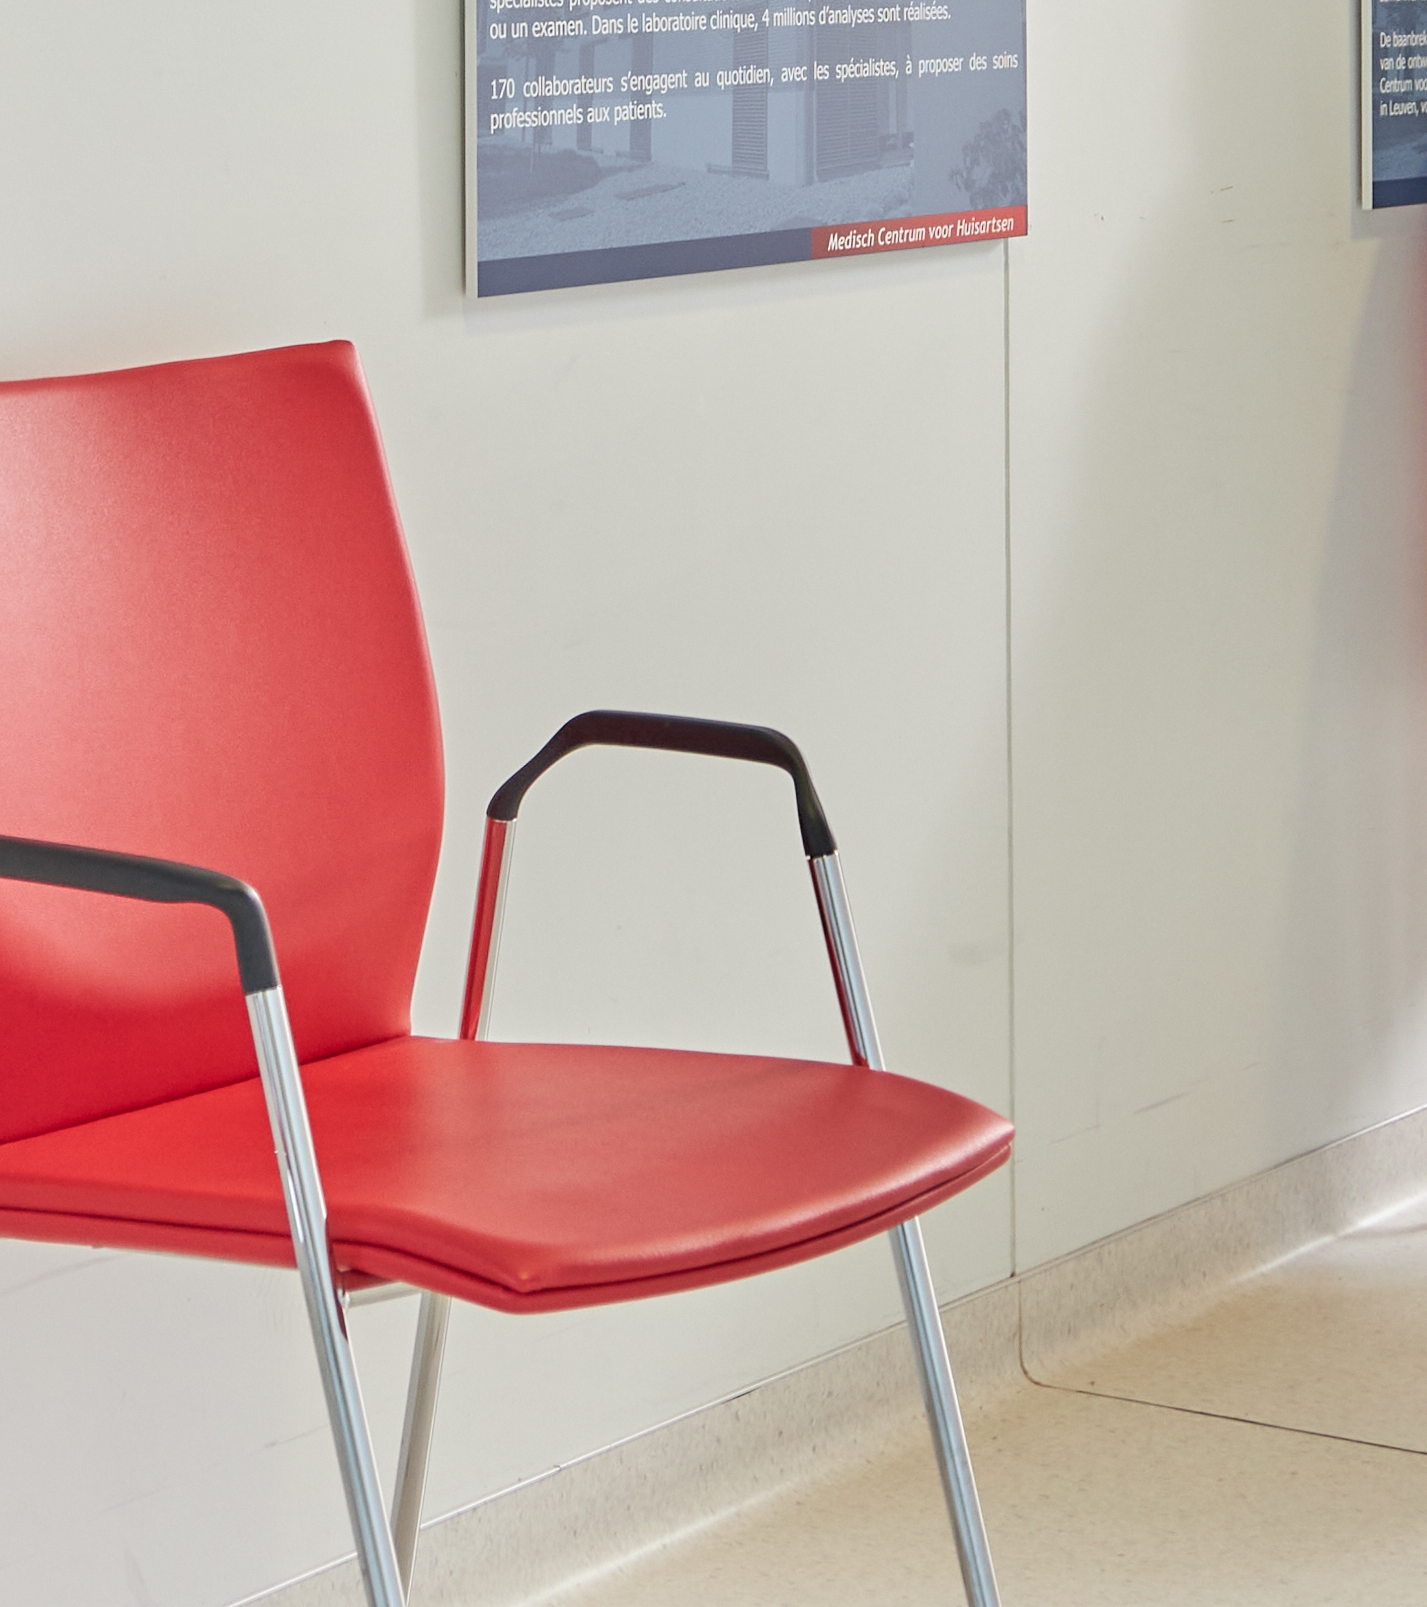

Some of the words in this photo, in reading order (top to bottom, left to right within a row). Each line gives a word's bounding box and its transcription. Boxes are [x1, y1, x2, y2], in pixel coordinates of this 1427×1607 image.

[489, 22, 506, 39] ou
[511, 22, 528, 38] un
[531, 19, 587, 37] examen.
[591, 14, 623, 34] Dans
[627, 13, 638, 33] le
[642, 11, 706, 32] laboratoire
[710, 9, 758, 33] clinique,
[761, 8, 769, 27] 4
[773, 6, 815, 26] millions
[818, 4, 874, 27] d’analyses
[877, 3, 900, 22] sont
[903, 0, 950, 21] réalisées.
[1379, 31, 1391, 48] De
[1379, 76, 1412, 93] Centrum
[489, 103, 583, 135] professionnels
[586, 106, 609, 123] aux
[614, 99, 666, 125] patients.
[827, 228, 874, 251] Medisch
[877, 226, 925, 245] Centrum
[928, 224, 954, 239] voor
[956, 216, 1013, 236] Huisartsen
